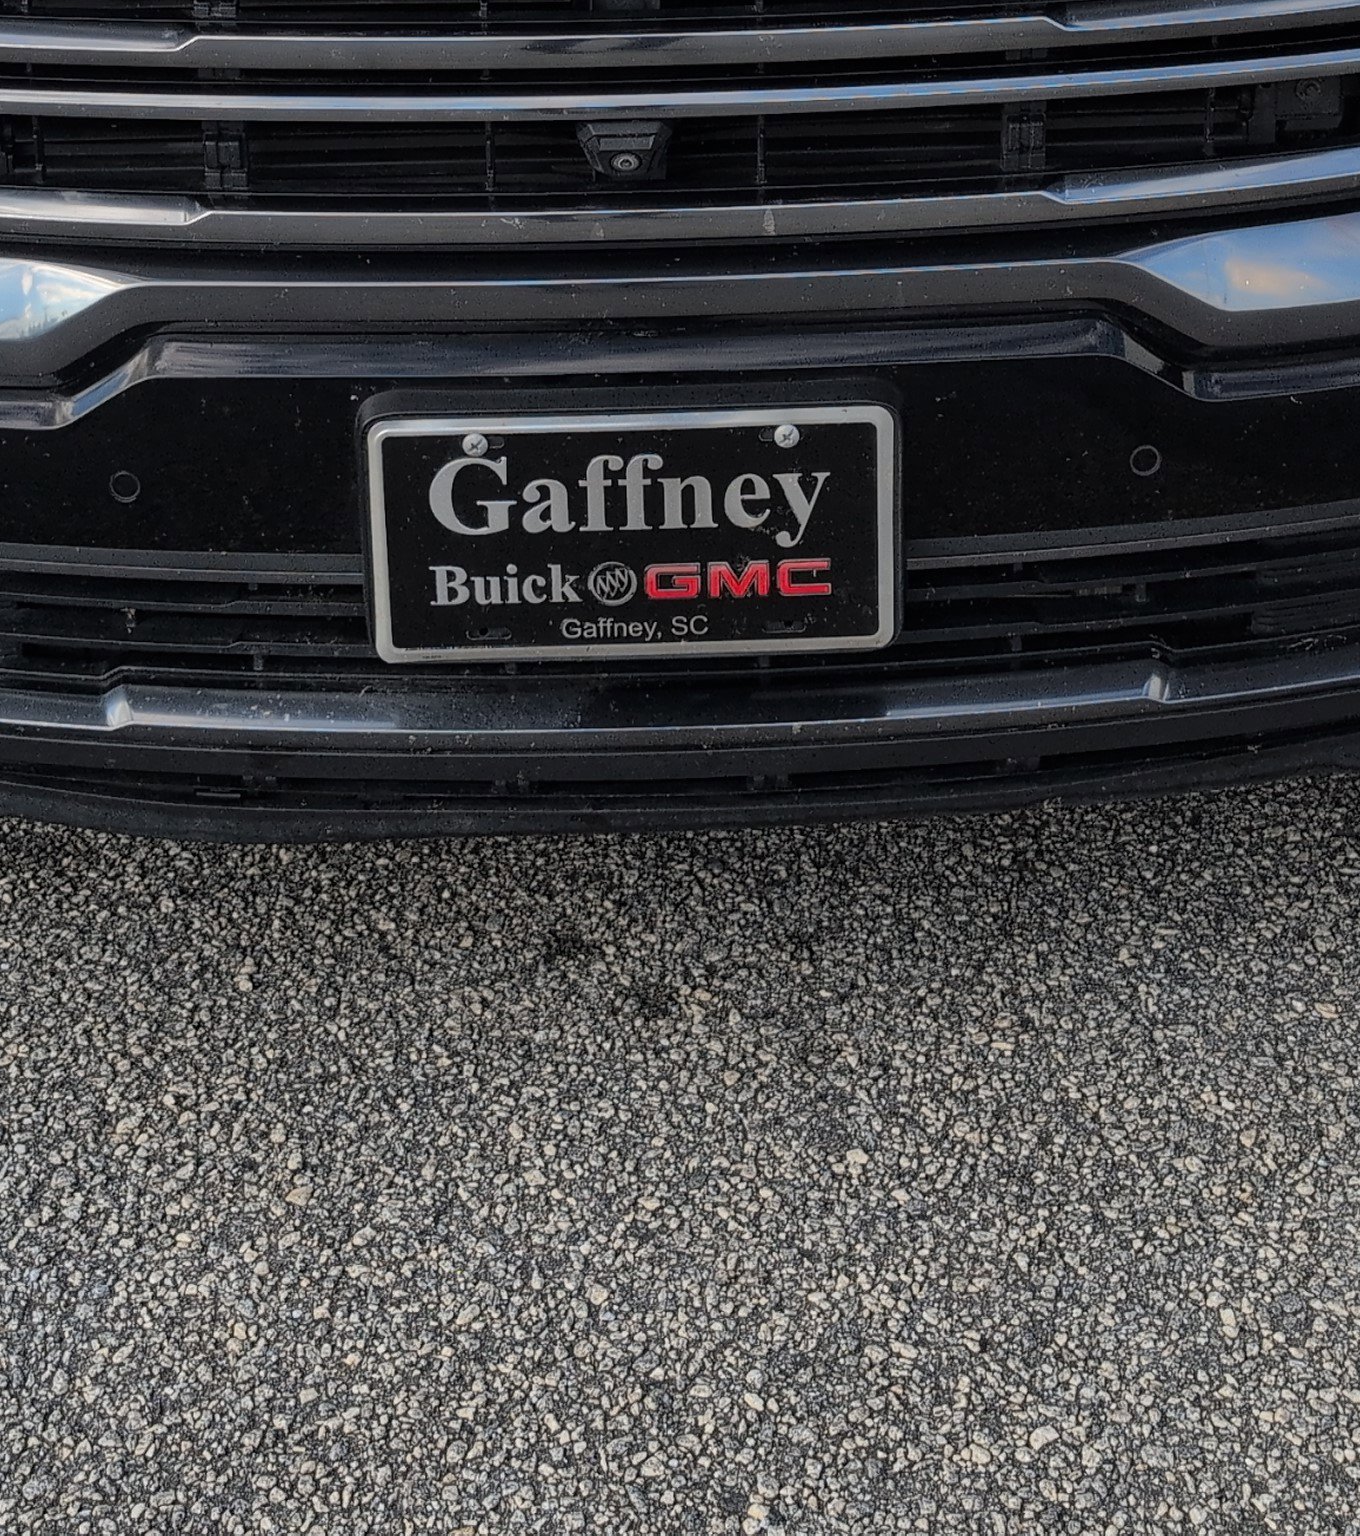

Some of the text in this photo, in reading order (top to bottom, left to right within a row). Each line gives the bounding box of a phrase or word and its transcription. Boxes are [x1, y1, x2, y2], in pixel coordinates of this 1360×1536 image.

[428, 453, 831, 548] Gaffney
[429, 557, 832, 607] Buick GMC
[560, 614, 710, 641] Gaffney, SC
